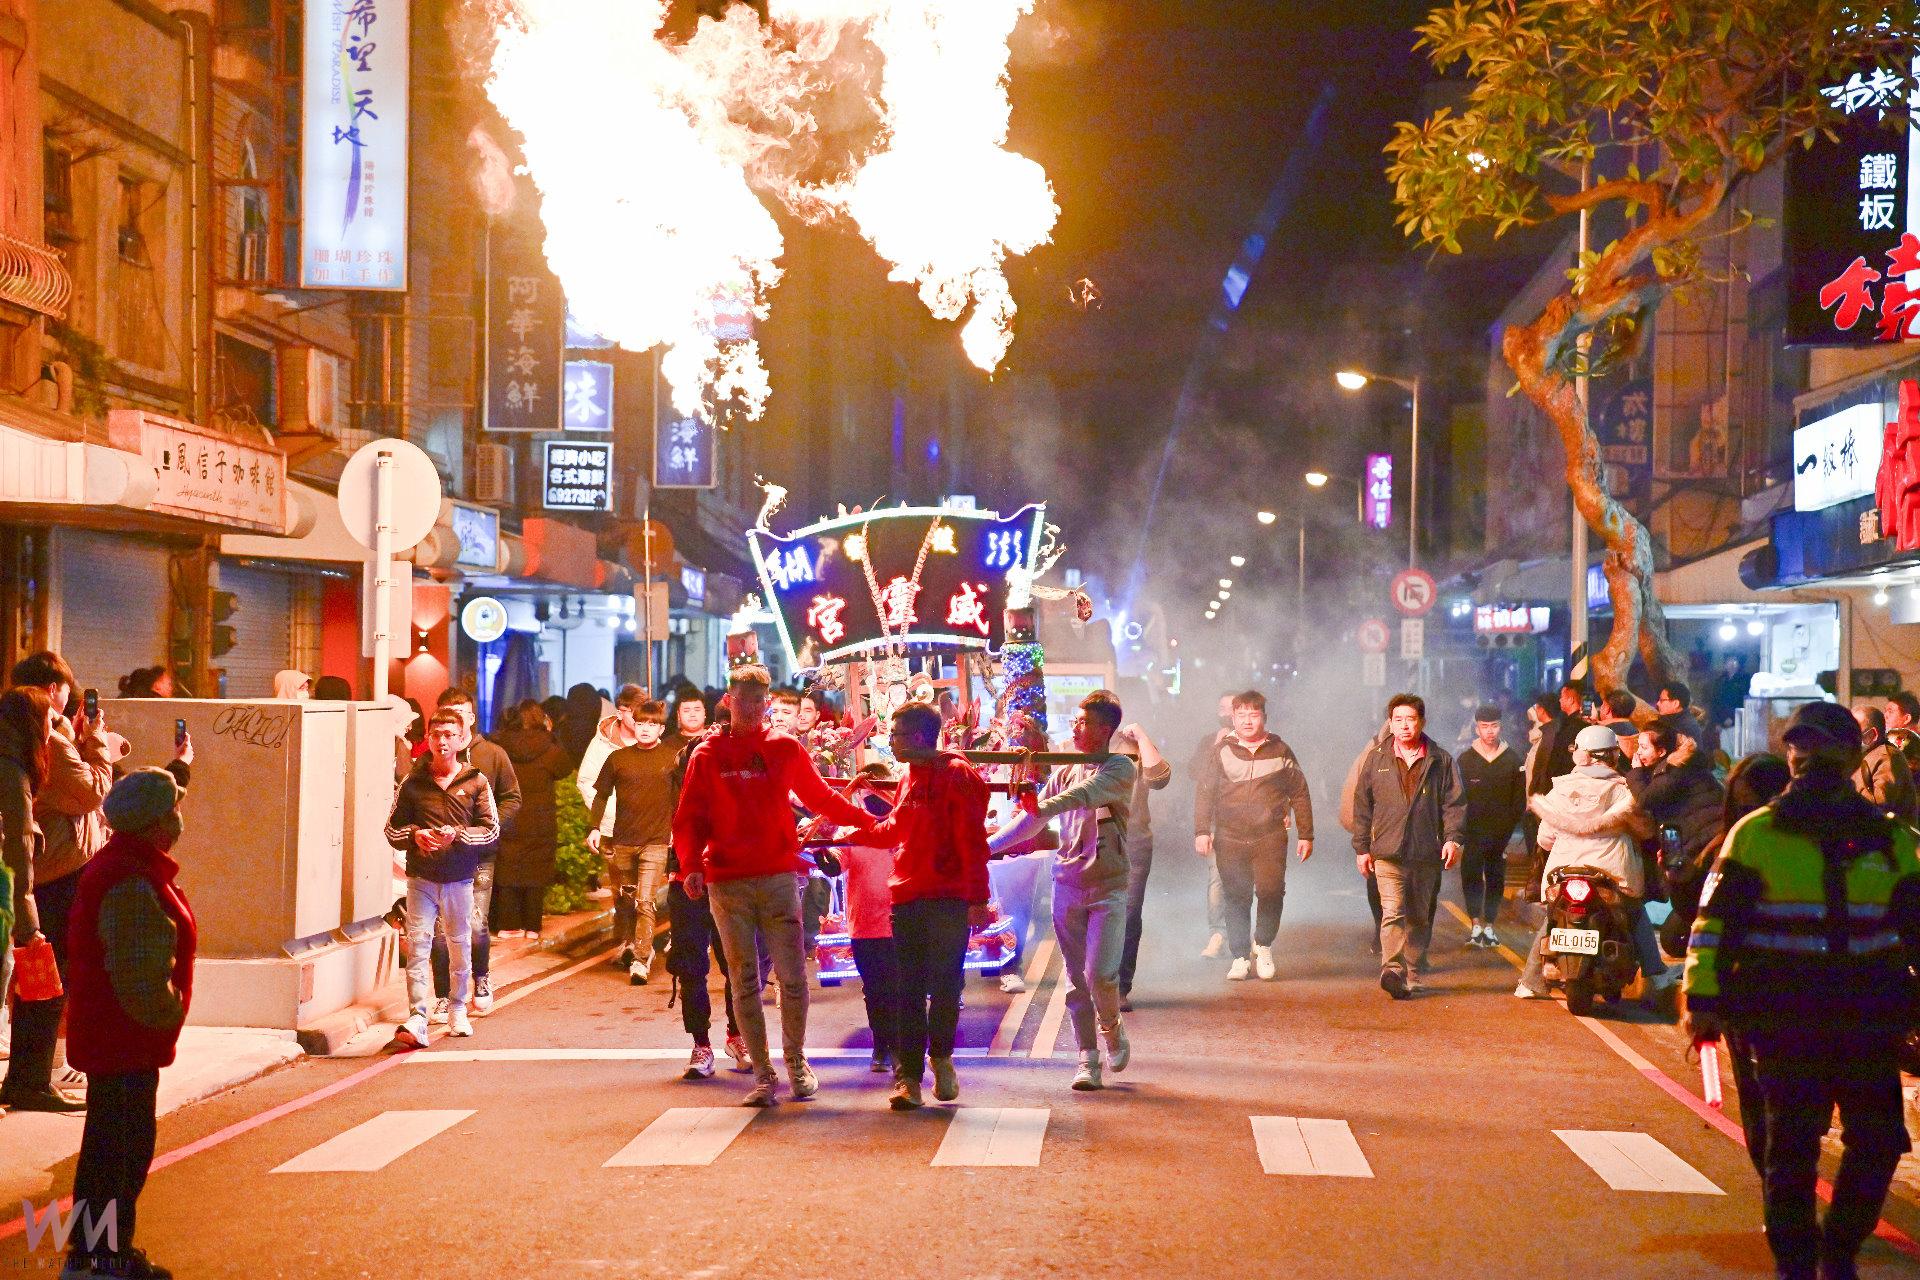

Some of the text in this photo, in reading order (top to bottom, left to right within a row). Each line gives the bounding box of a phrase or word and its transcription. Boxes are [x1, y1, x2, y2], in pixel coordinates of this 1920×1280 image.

[331, 0, 378, 147] 希望天地
[1859, 153, 1897, 230] 鐵板
[313, 249, 393, 264] 珊瑚珍珠
[505, 276, 543, 413] 阿華海鮮
[177, 442, 275, 496] 風信子咖啡館
[550, 448, 606, 467] 經濟小吃
[550, 467, 605, 486] 各式海鮮
